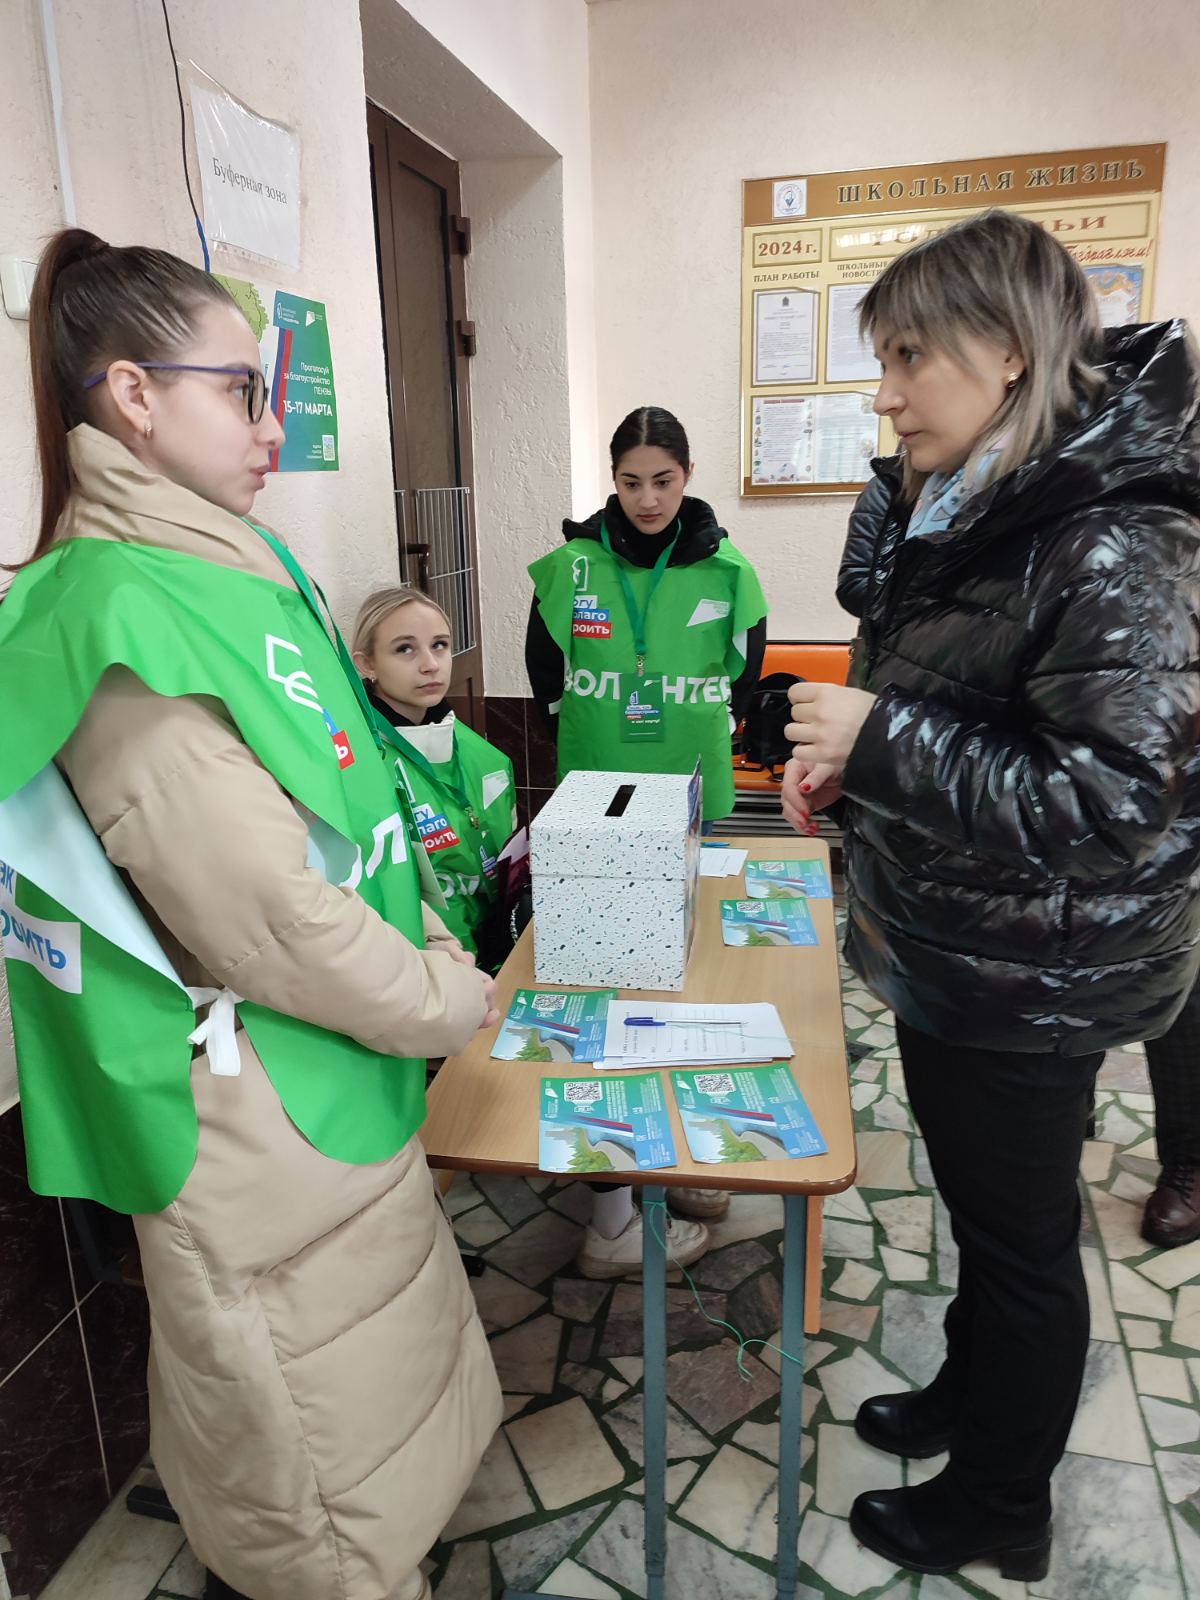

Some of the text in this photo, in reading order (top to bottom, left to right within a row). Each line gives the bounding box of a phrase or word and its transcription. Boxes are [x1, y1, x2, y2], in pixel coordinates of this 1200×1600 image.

[212, 157, 287, 205] Буферная зона
[837, 170, 1015, 203] ШКОЛЬНАЯ
[1025, 158, 1144, 188] ЖИЗНЬ
[758, 240, 817, 257] 2024 г.
[754, 270, 820, 283] ПЛАН РАБОТЫ
[301, 361, 330, 376] Проголосуй
[304, 402, 333, 417] МАРТА
[573, 624, 610, 636] роить
